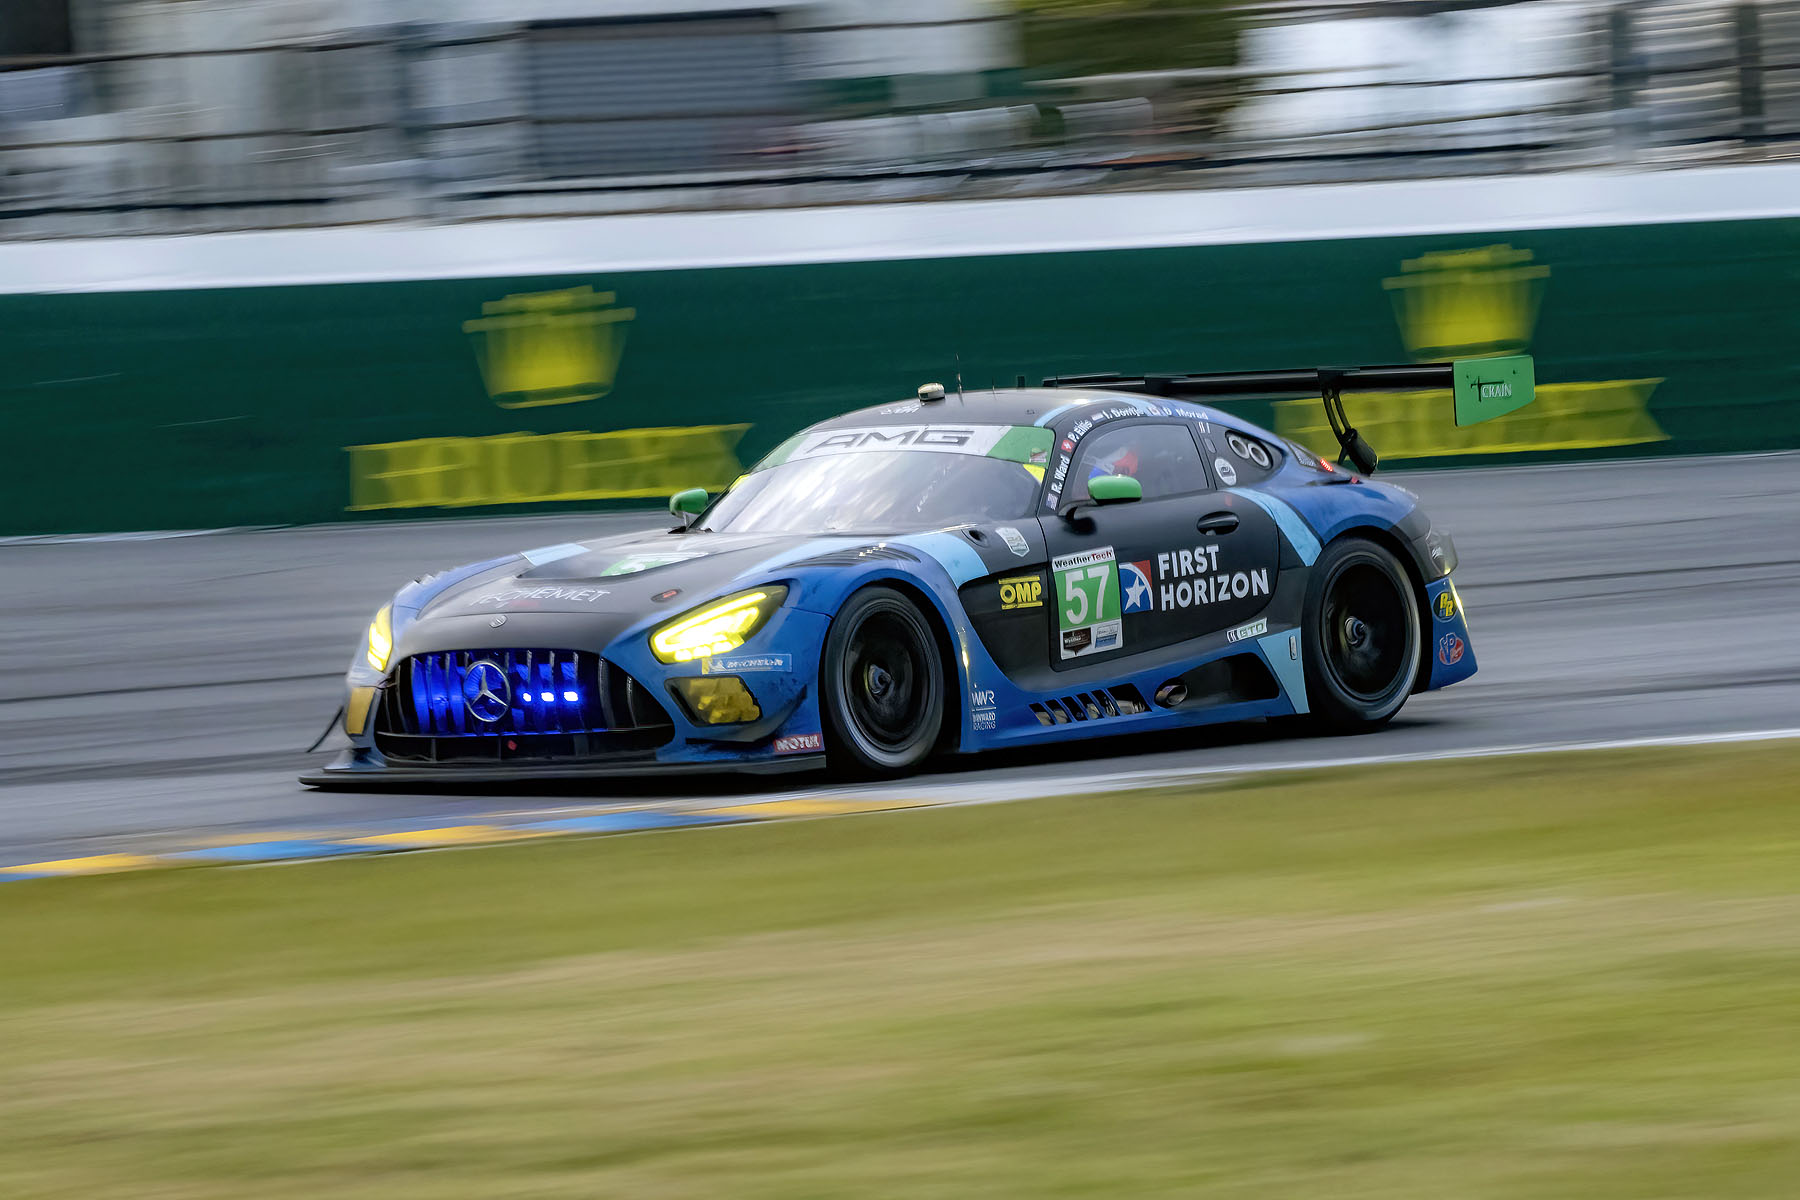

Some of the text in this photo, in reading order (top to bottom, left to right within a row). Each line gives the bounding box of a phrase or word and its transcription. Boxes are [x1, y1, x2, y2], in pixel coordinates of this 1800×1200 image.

[806, 430, 975, 454] AMG
[1054, 454, 1070, 481] Ward
[1054, 550, 1113, 569] WeatherTech
[1158, 544, 1219, 580] FIRST
[1000, 581, 1042, 604] OMP
[1065, 568, 1110, 625] 57
[1160, 568, 1270, 612] HORIZON
[775, 735, 820, 751] MOTUL
